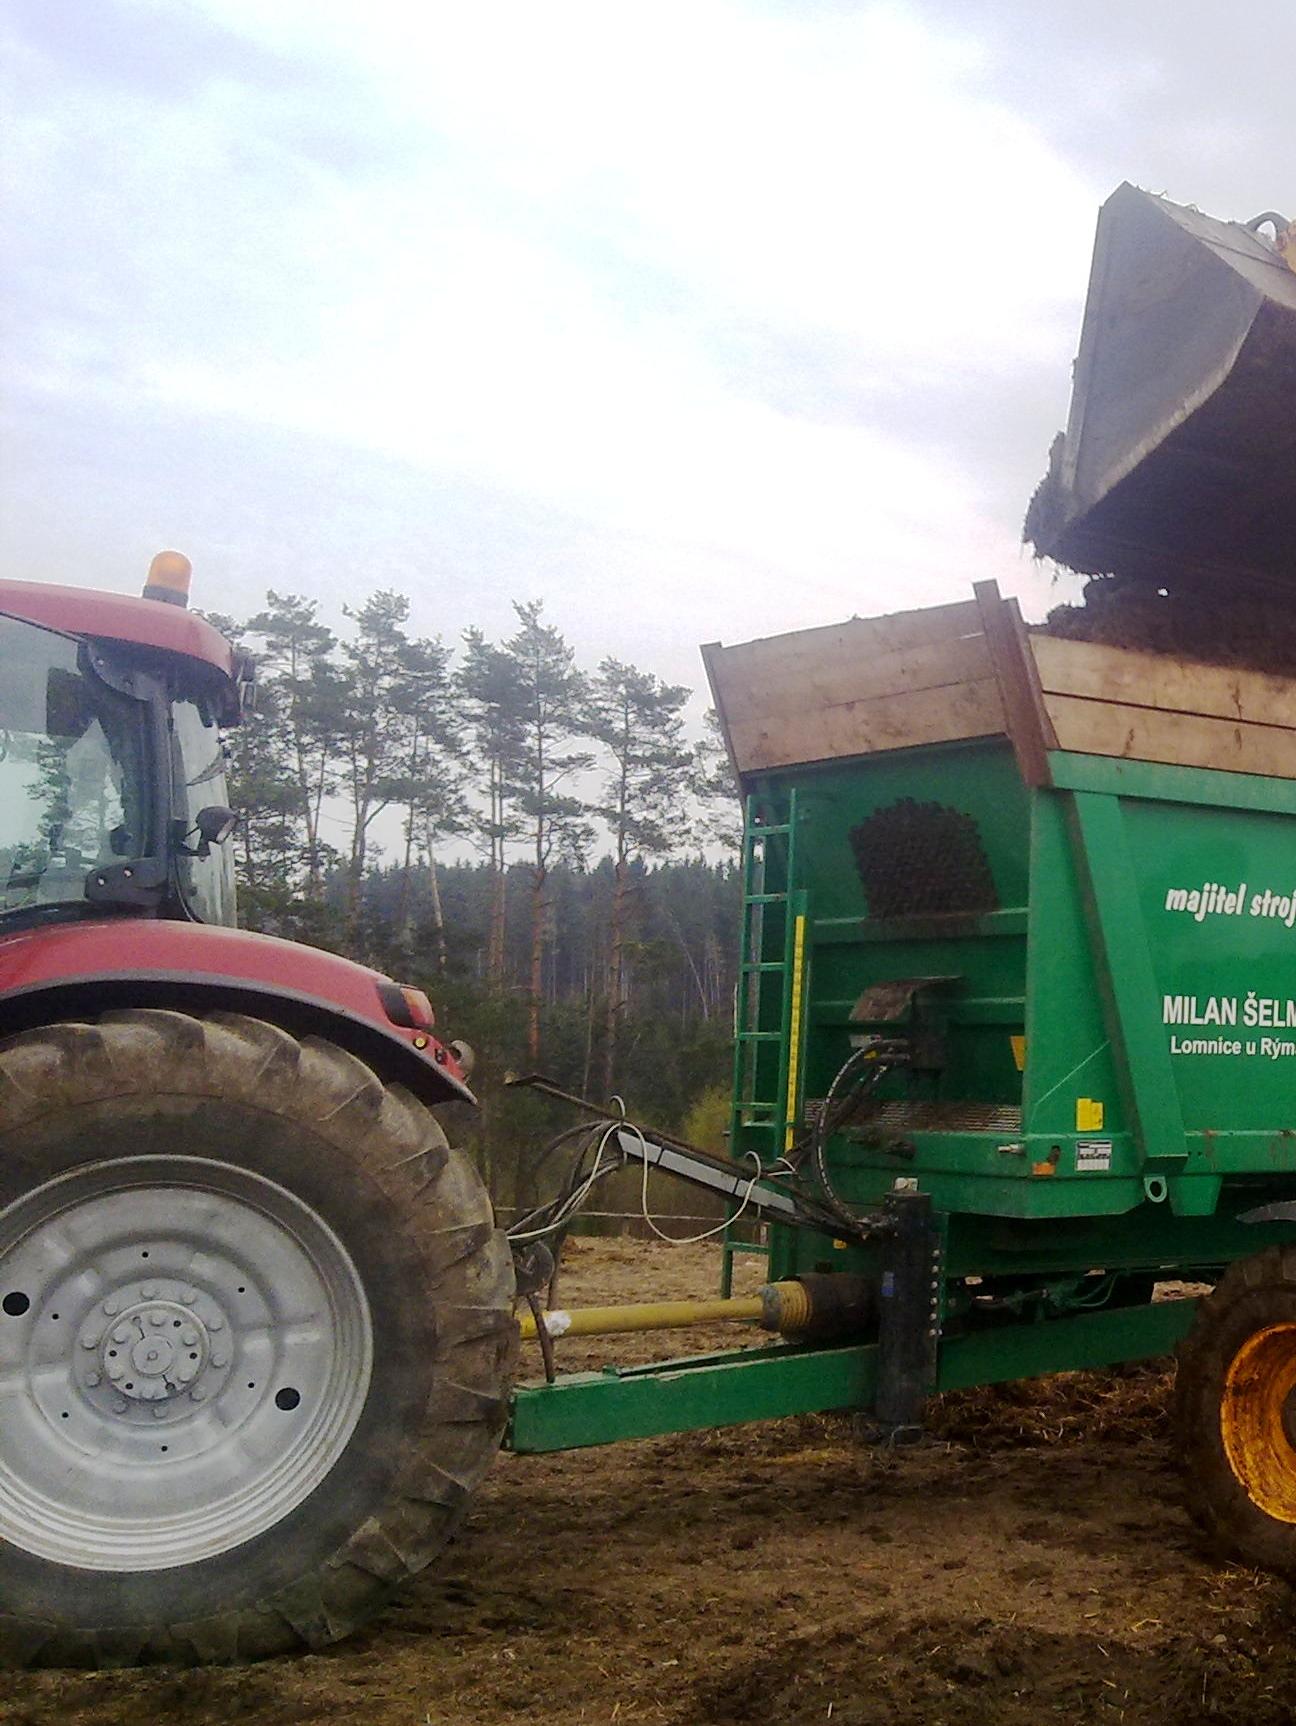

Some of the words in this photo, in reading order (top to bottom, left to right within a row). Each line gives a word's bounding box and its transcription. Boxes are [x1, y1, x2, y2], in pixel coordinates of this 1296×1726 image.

[1165, 882, 1247, 922] majitel
[1163, 995, 1237, 1026] MILAN
[1171, 1036, 1241, 1055] Lomnice
[1246, 1041, 1256, 1054] u
